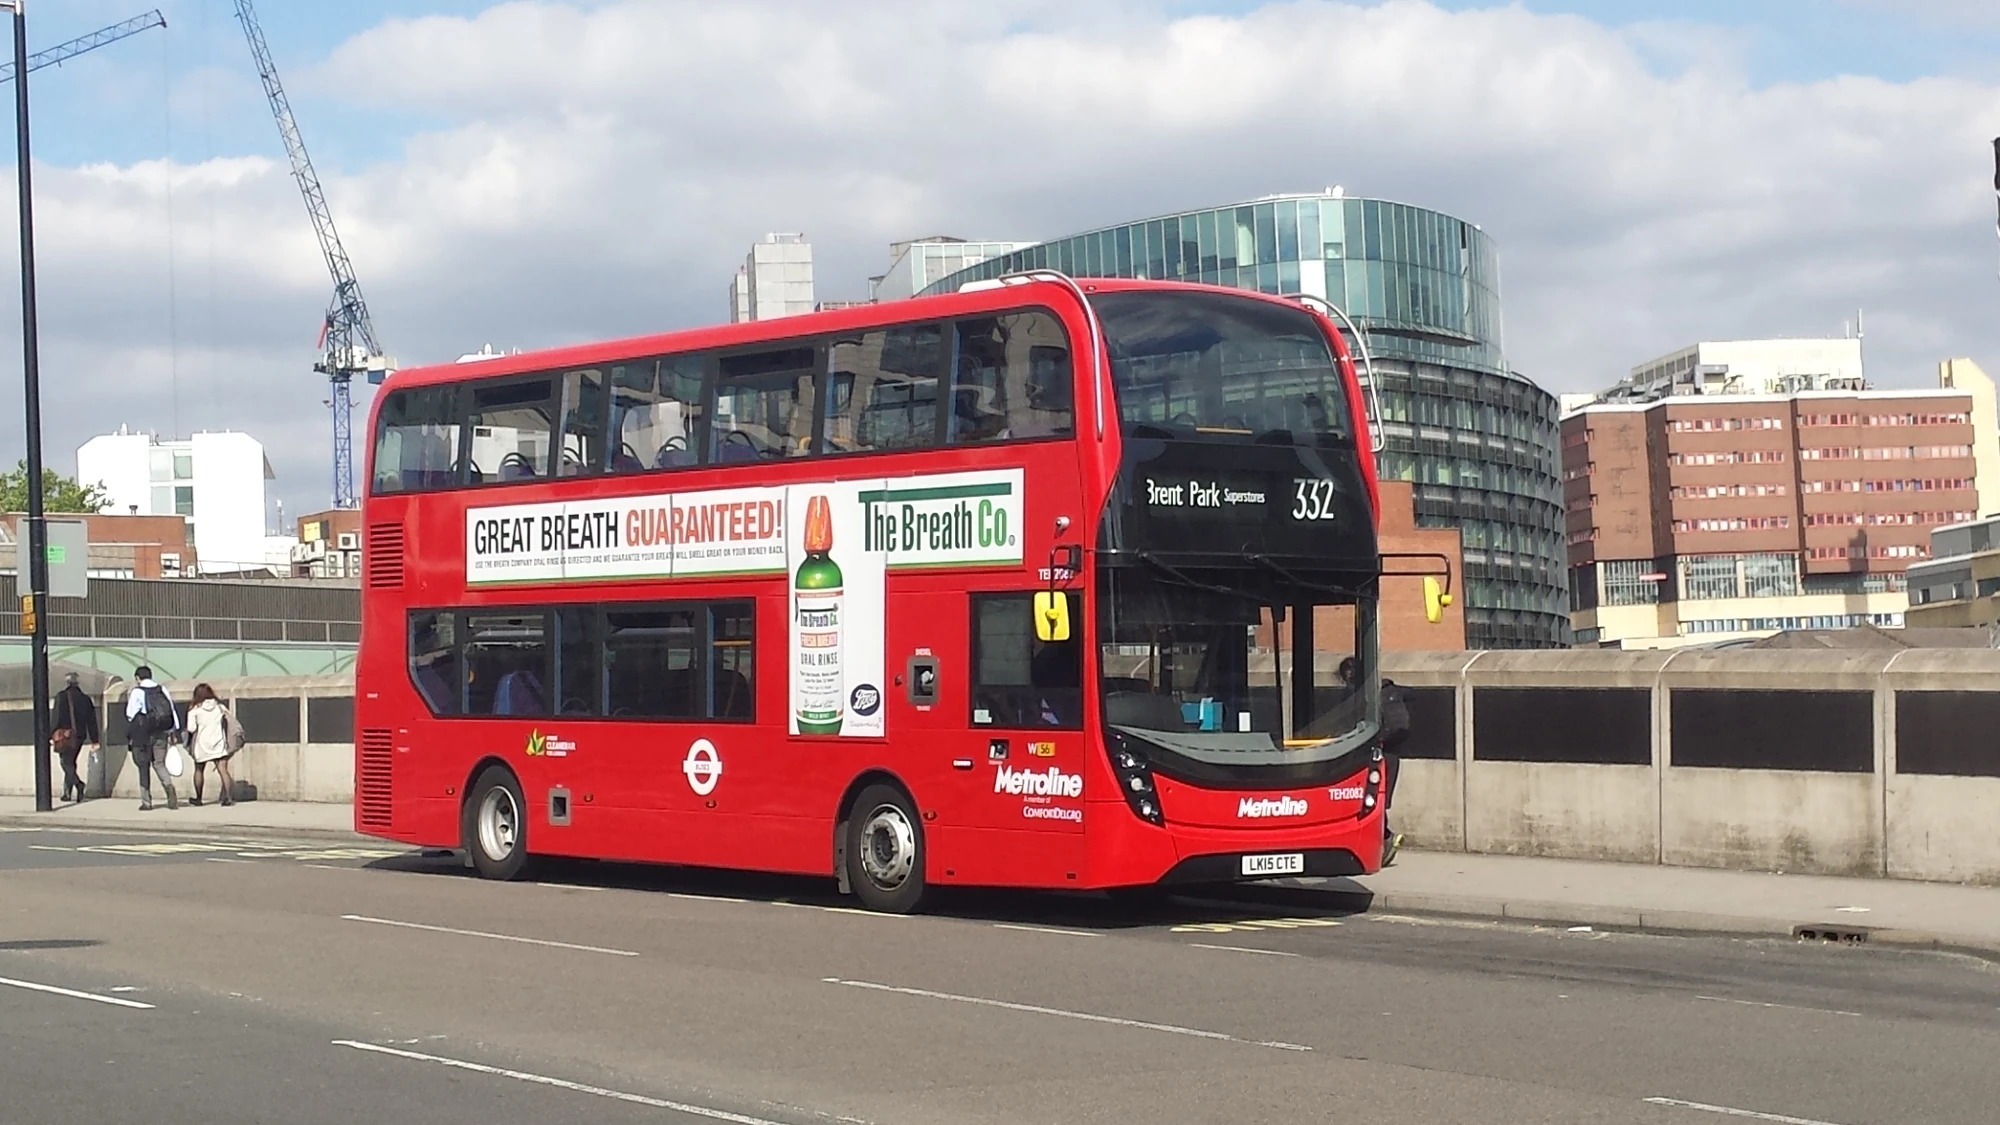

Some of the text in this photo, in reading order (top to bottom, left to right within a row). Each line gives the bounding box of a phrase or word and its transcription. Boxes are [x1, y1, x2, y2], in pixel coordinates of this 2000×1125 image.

[1146, 479, 1266, 507] Brent Park Superstores
[1292, 478, 1335, 520] 332
[475, 499, 783, 555] GREAT BREATH GUARANTEED!
[858, 490, 897, 552] The
[902, 500, 972, 551] Breath
[494, 560, 510, 568] BREATH
[511, 559, 532, 568] COMPANY
[534, 558, 545, 567] ORAL
[547, 557, 559, 566] RINSE
[568, 555, 591, 565] DIRECTED
[612, 553, 640, 562] GUARANTEE
[641, 552, 654, 561] YOUR
[676, 550, 688, 559] WILL
[689, 550, 705, 559] SMELL
[706, 548, 722, 558] GREAT
[723, 548, 731, 556] OR
[732, 547, 746, 556] YOUR
[748, 546, 766, 555] MONEY
[769, 545, 784, 554] BACK.
[818, 651, 838, 666] RINSE
[1028, 743, 1037, 755] W
[994, 764, 1083, 798] Metroline
[1328, 787, 1363, 801] TEH2082
[1237, 796, 1308, 818] Metroline
[1249, 856, 1296, 871] LK15 CTE
